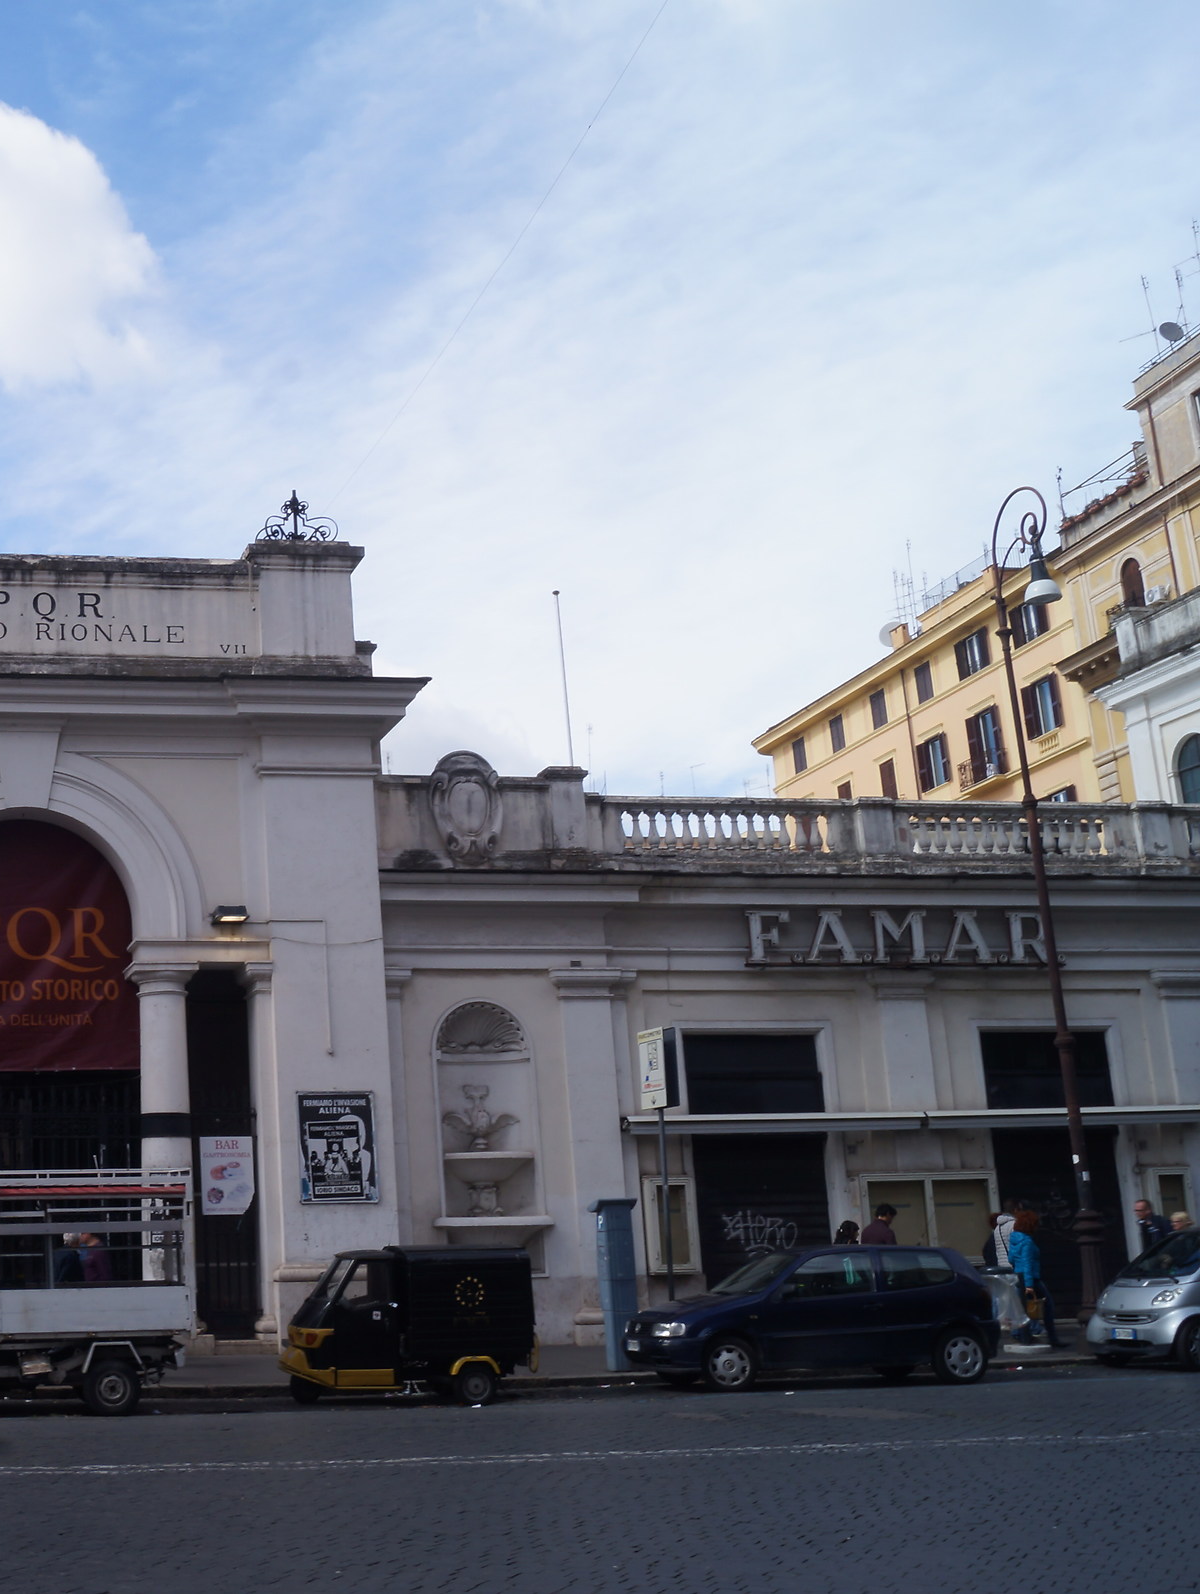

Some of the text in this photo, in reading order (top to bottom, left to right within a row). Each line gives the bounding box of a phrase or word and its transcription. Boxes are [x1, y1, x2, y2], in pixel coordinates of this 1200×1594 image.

[36, 622, 186, 644] RIONALE
[219, 643, 248, 655] VII
[31, 979, 119, 1001] STORICO
[10, 1011, 93, 1026] DELL'UNITÀ
[303, 1099, 333, 1107] FERMIAMO
[215, 1140, 239, 1150] BAR
